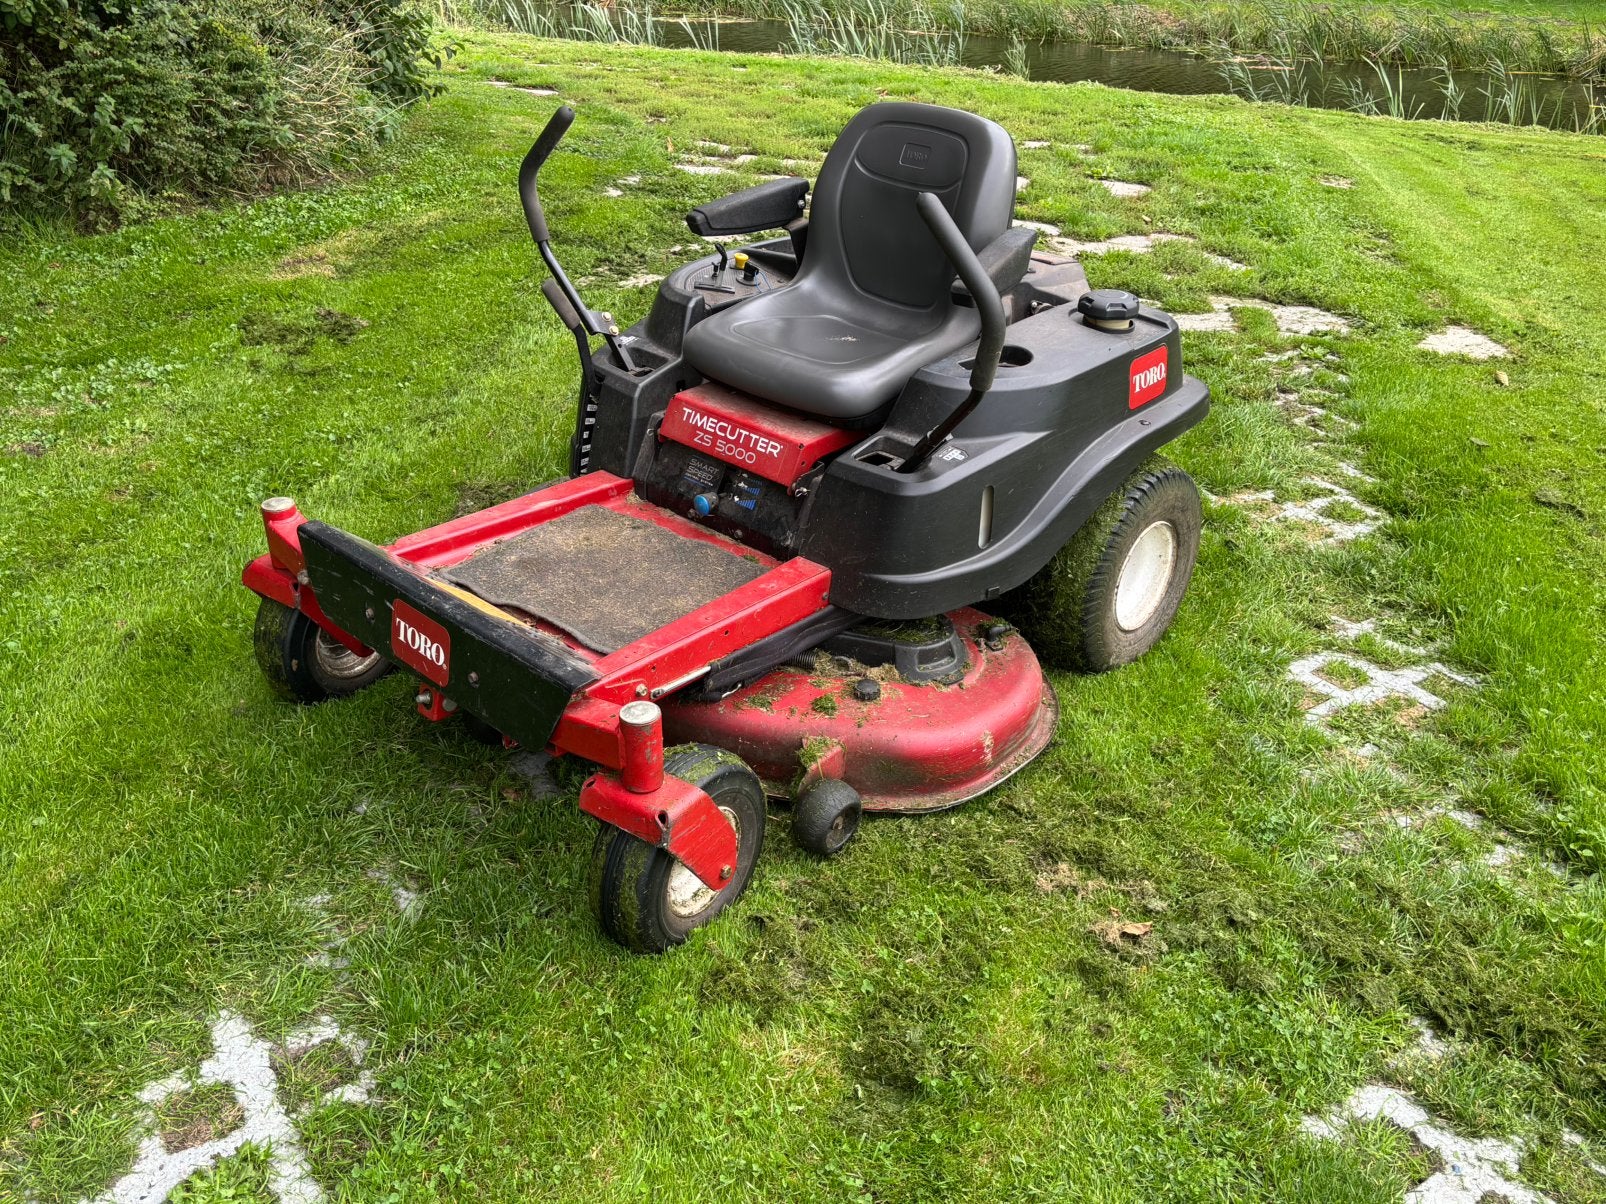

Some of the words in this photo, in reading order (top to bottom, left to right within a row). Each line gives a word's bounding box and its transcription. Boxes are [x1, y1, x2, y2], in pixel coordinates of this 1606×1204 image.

[1132, 362, 1166, 393] TORO
[682, 407, 780, 458] TIMECUTTER
[693, 430, 713, 447] ZS
[715, 439, 756, 464] 5000
[686, 465, 713, 481] SPEED
[689, 458, 719, 475] SMART
[396, 617, 445, 666] TORO
